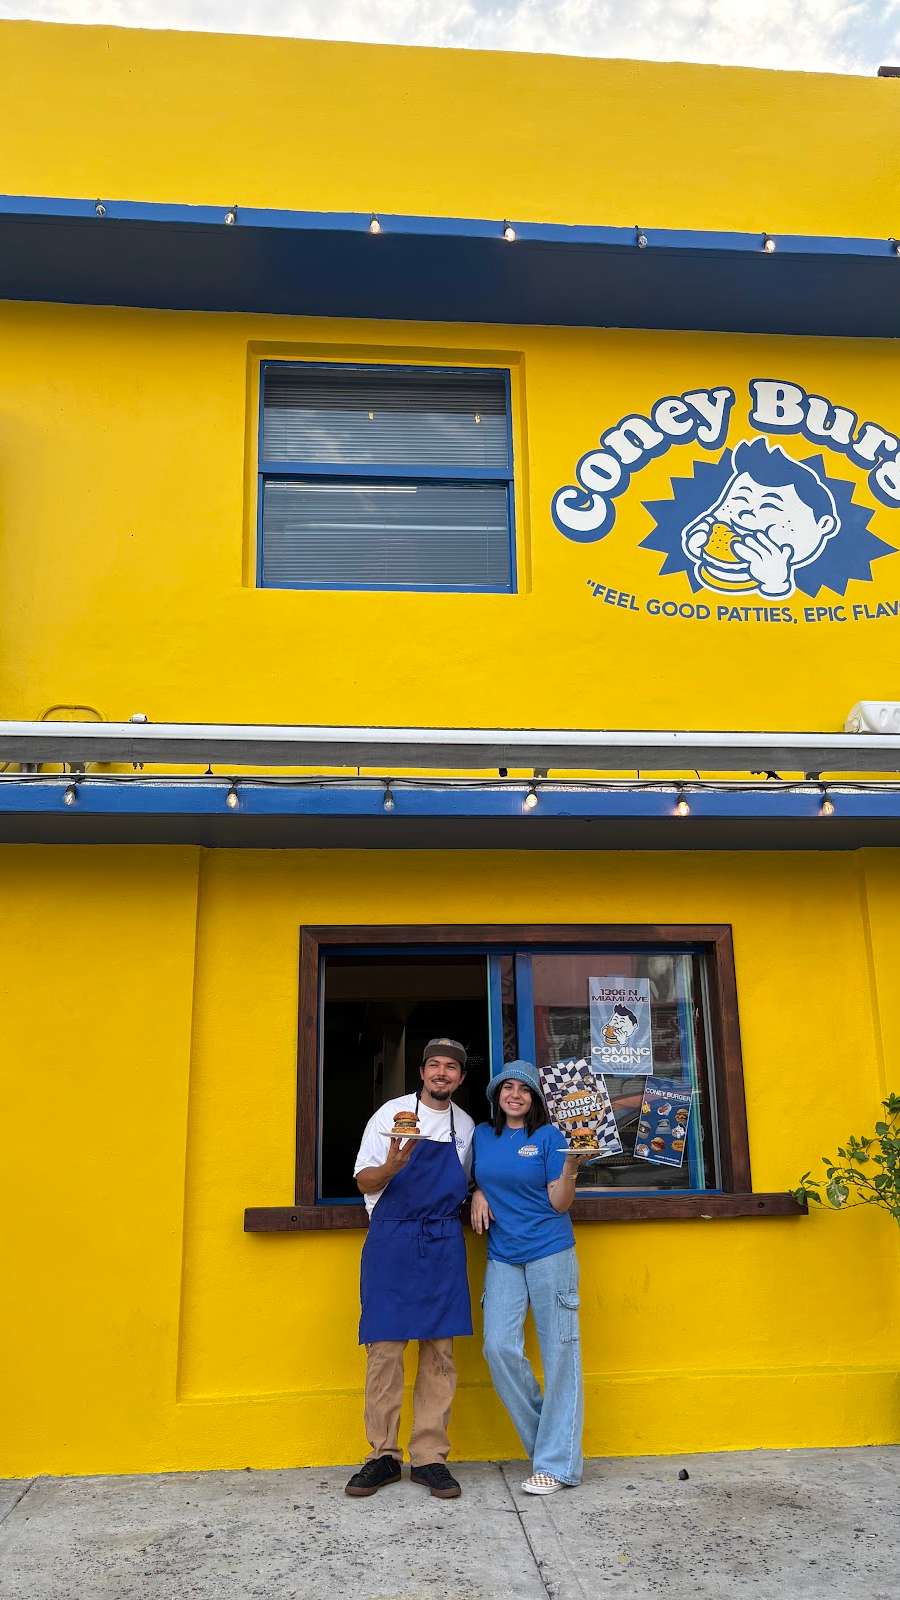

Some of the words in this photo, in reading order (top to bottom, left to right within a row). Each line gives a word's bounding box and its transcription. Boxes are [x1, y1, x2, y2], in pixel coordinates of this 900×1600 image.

[551, 386, 736, 542] Coney
[646, 599, 711, 620] GOOD
[717, 606, 798, 624] PATTIES,
[804, 605, 847, 623] EPIC
[592, 1046, 650, 1055] COMING
[601, 1055, 641, 1064] SOON
[560, 1094, 598, 1110] Coney
[645, 1087, 666, 1097] CONEY
[666, 1092, 691, 1102] BURGER
[558, 1102, 603, 1120] Burger
